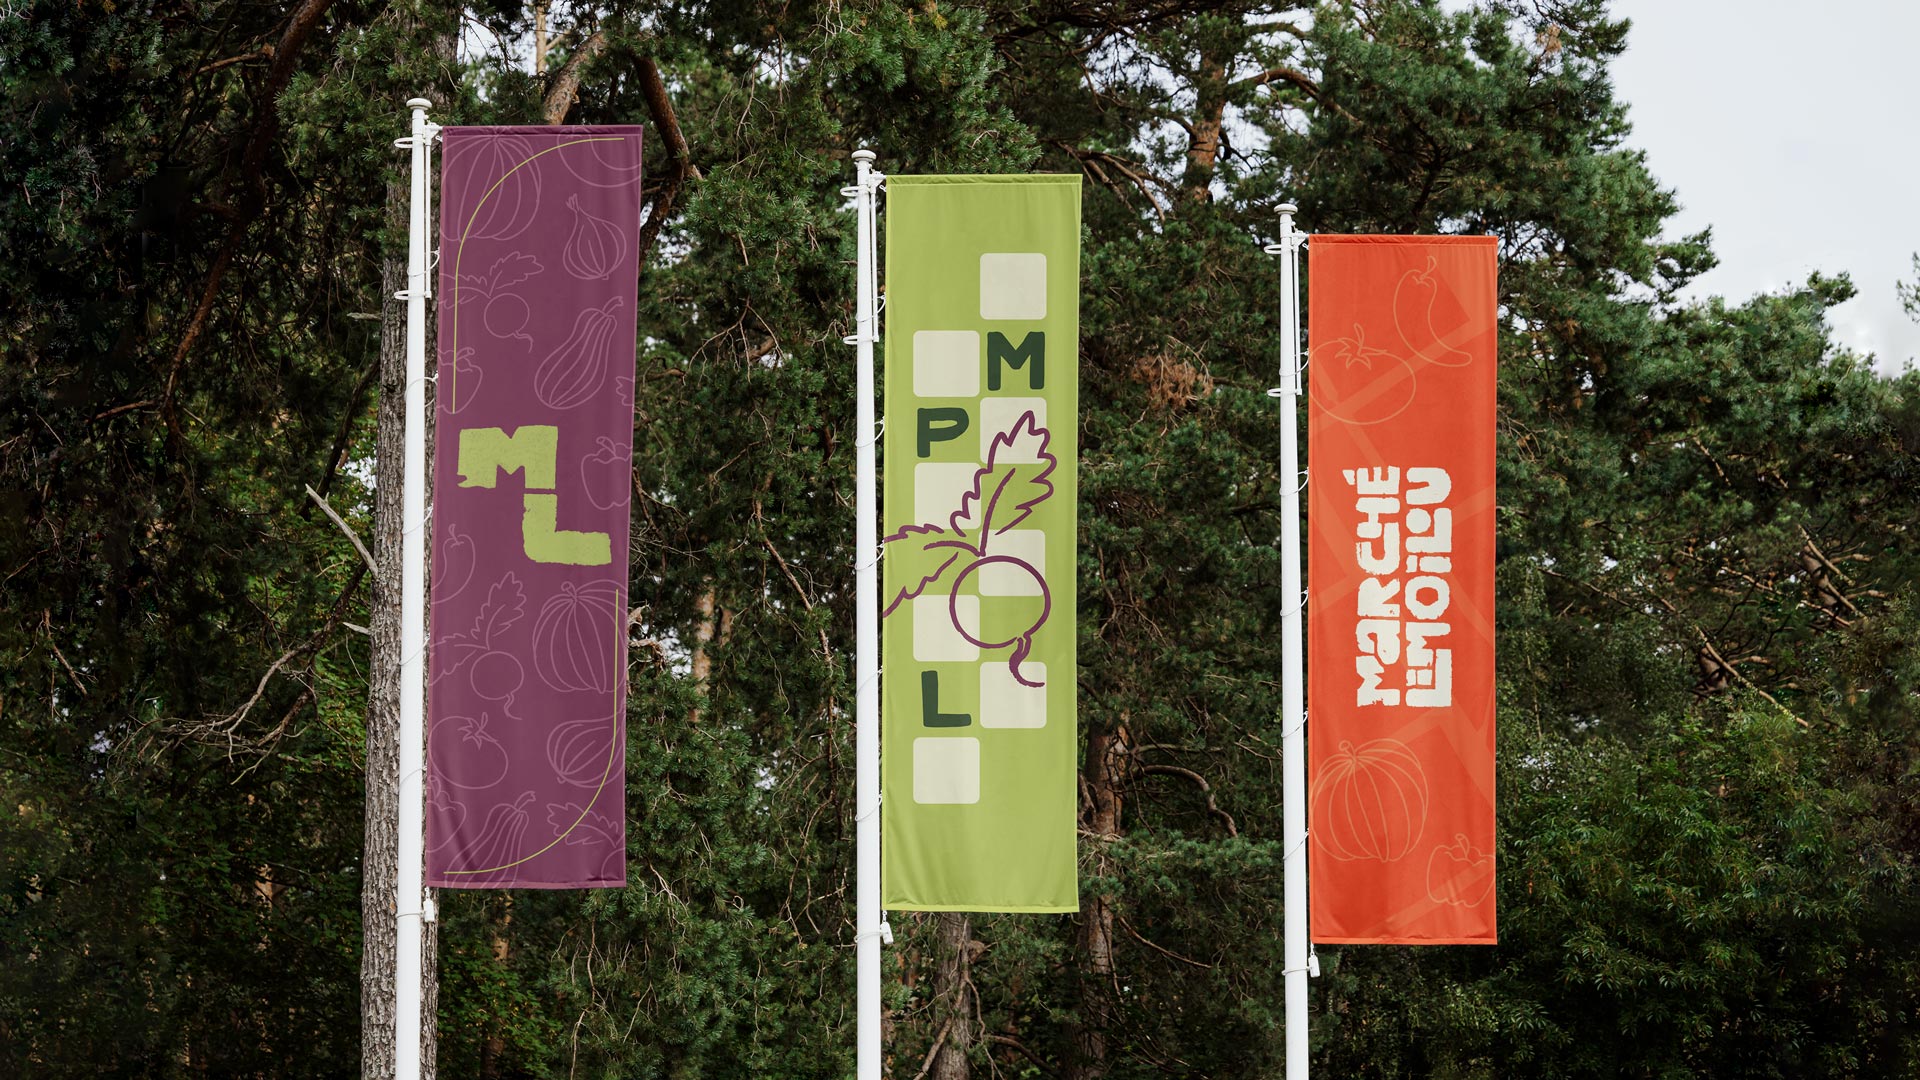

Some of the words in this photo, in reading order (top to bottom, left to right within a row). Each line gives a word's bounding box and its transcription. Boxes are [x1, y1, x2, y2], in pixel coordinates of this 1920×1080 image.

[987, 331, 1045, 391] M
[917, 407, 969, 458] P
[920, 670, 971, 727] L
